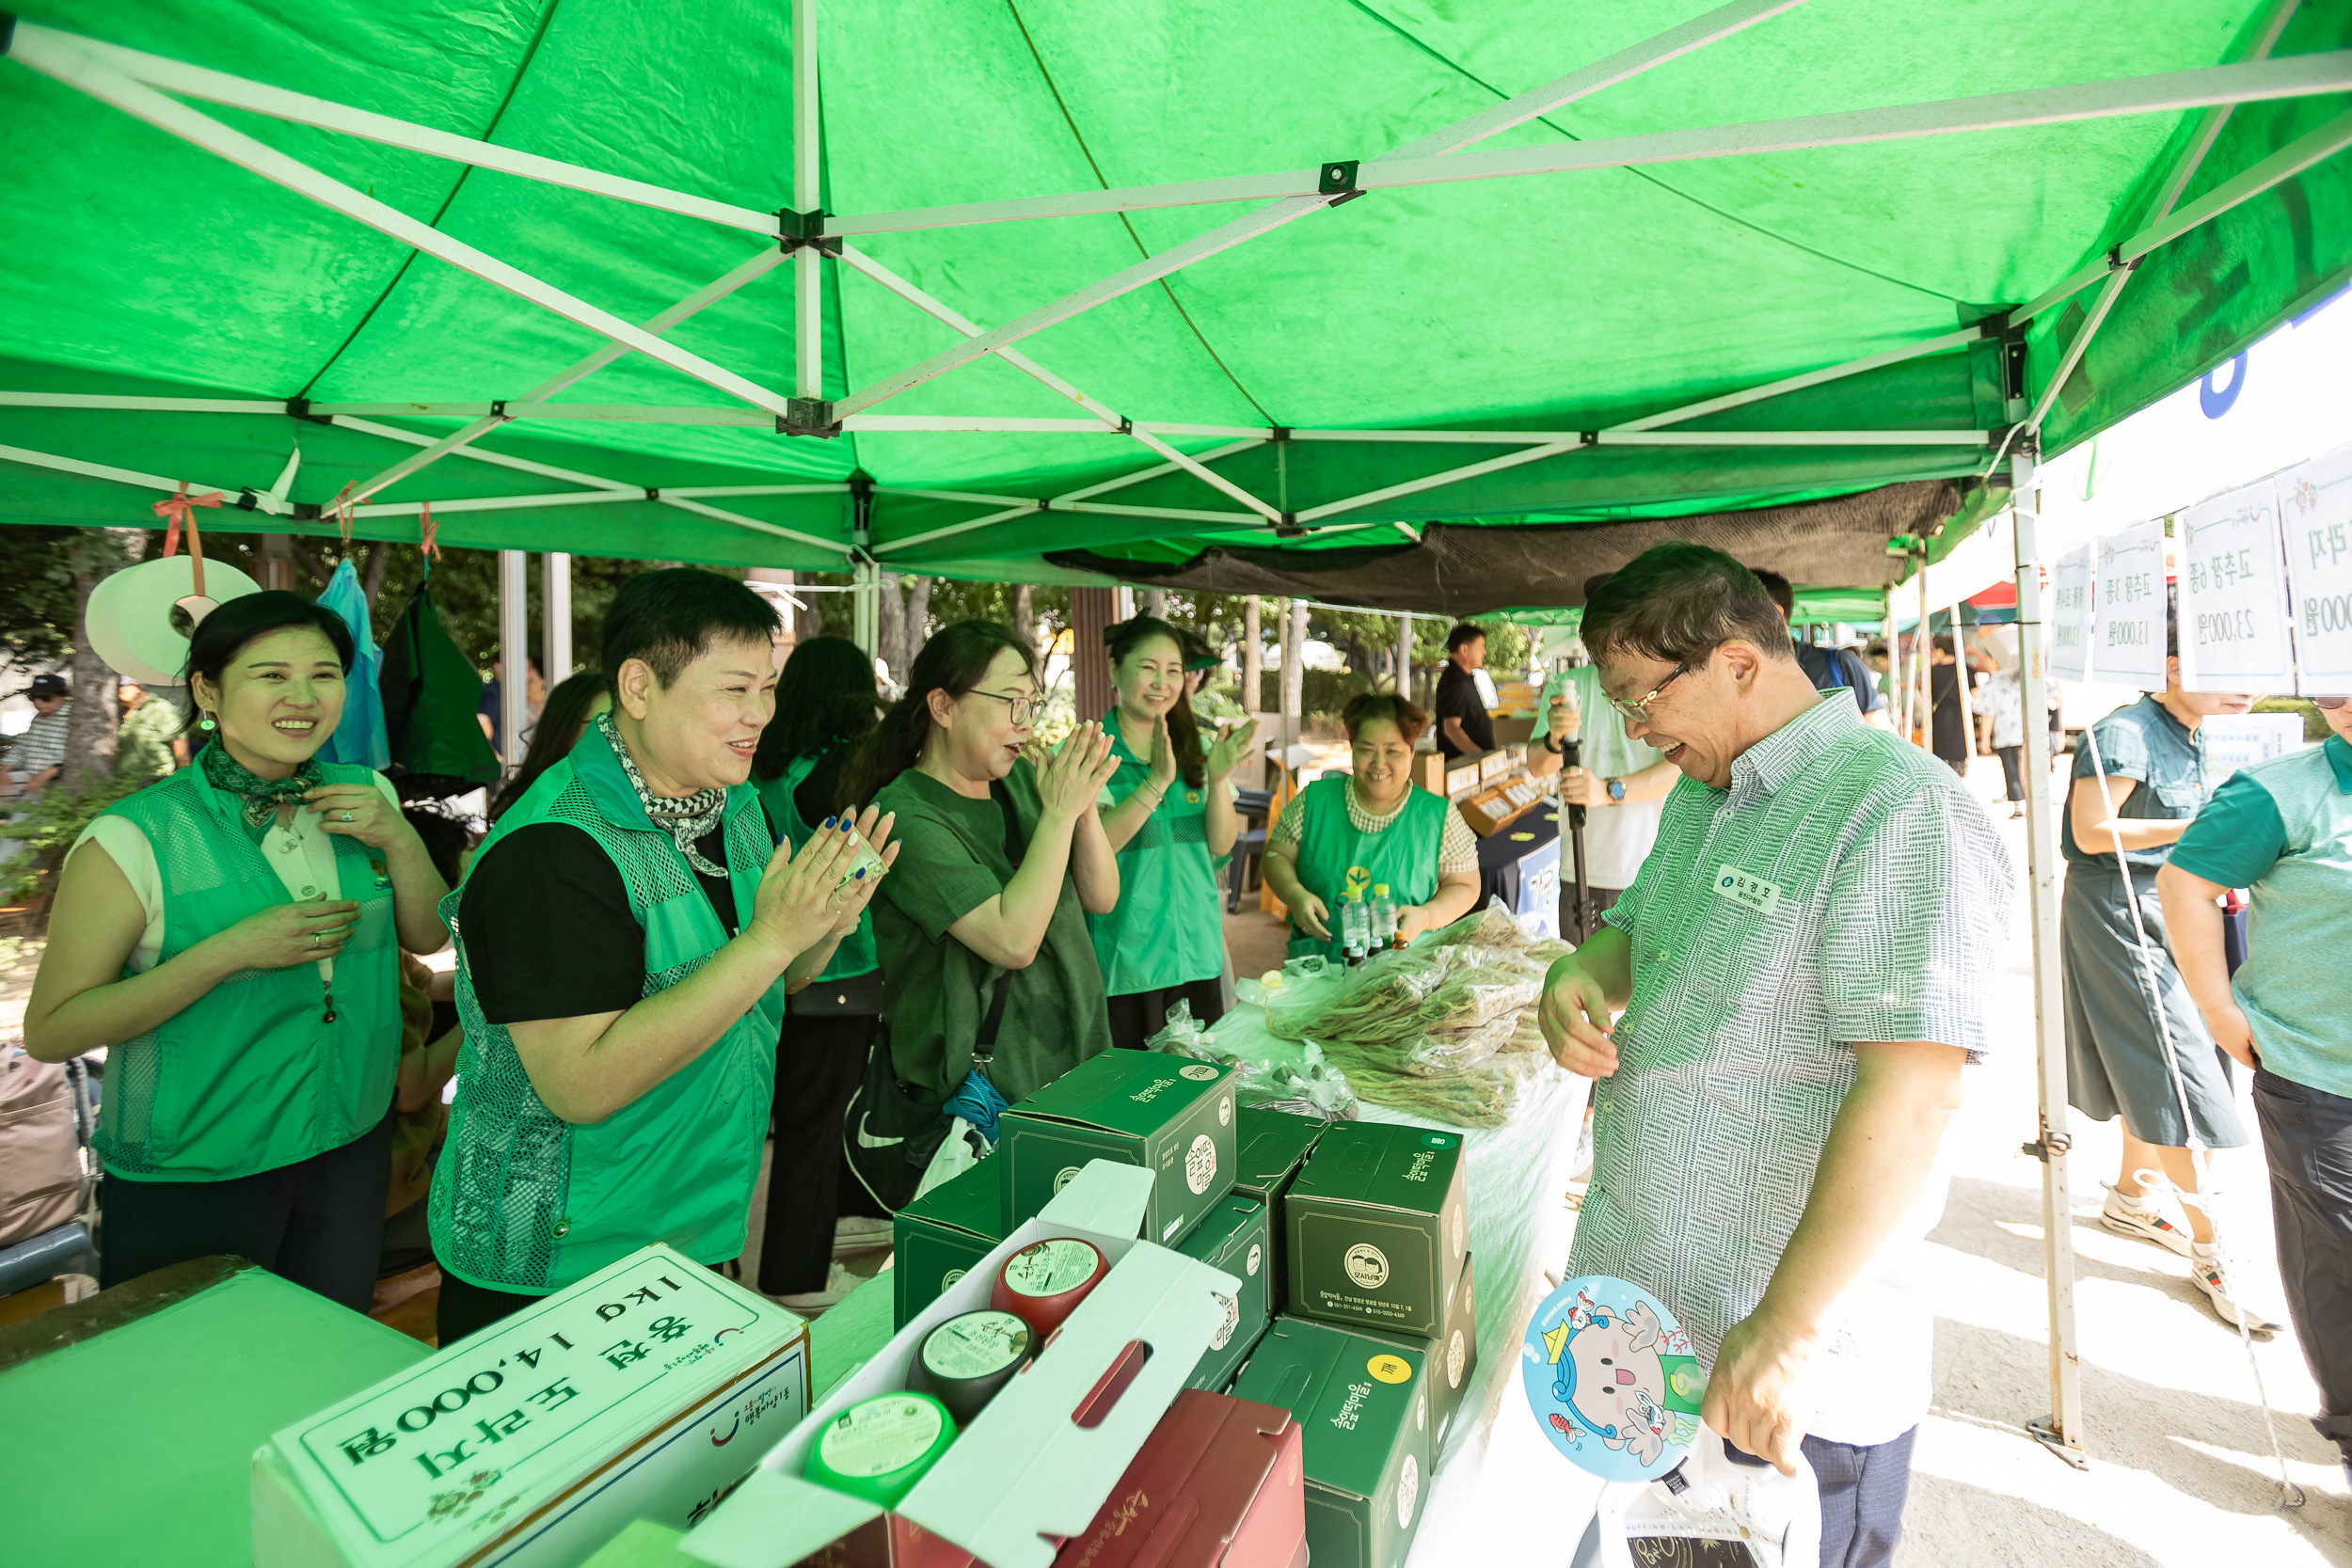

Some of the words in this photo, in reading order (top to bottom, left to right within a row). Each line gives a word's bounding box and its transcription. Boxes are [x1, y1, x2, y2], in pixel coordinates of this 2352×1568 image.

[1129, 1078, 1174, 1103] 솔잎떡마을
[1401, 1152, 1435, 1182] 솔잎떡마을
[1355, 1272, 1382, 1282] 모시남매
[595, 1276, 683, 1324] 1kg
[1333, 1302, 1363, 1312] 061-351-4349
[1372, 1308, 1406, 1319] 010-5050-4349
[598, 1316, 695, 1371] 홍천
[336, 1332, 575, 1468] 14,000원
[744, 1386, 790, 1426] 행복자양1동
[1330, 1383, 1371, 1431] 솔잎떡마을
[412, 1375, 581, 1481] 도라지
